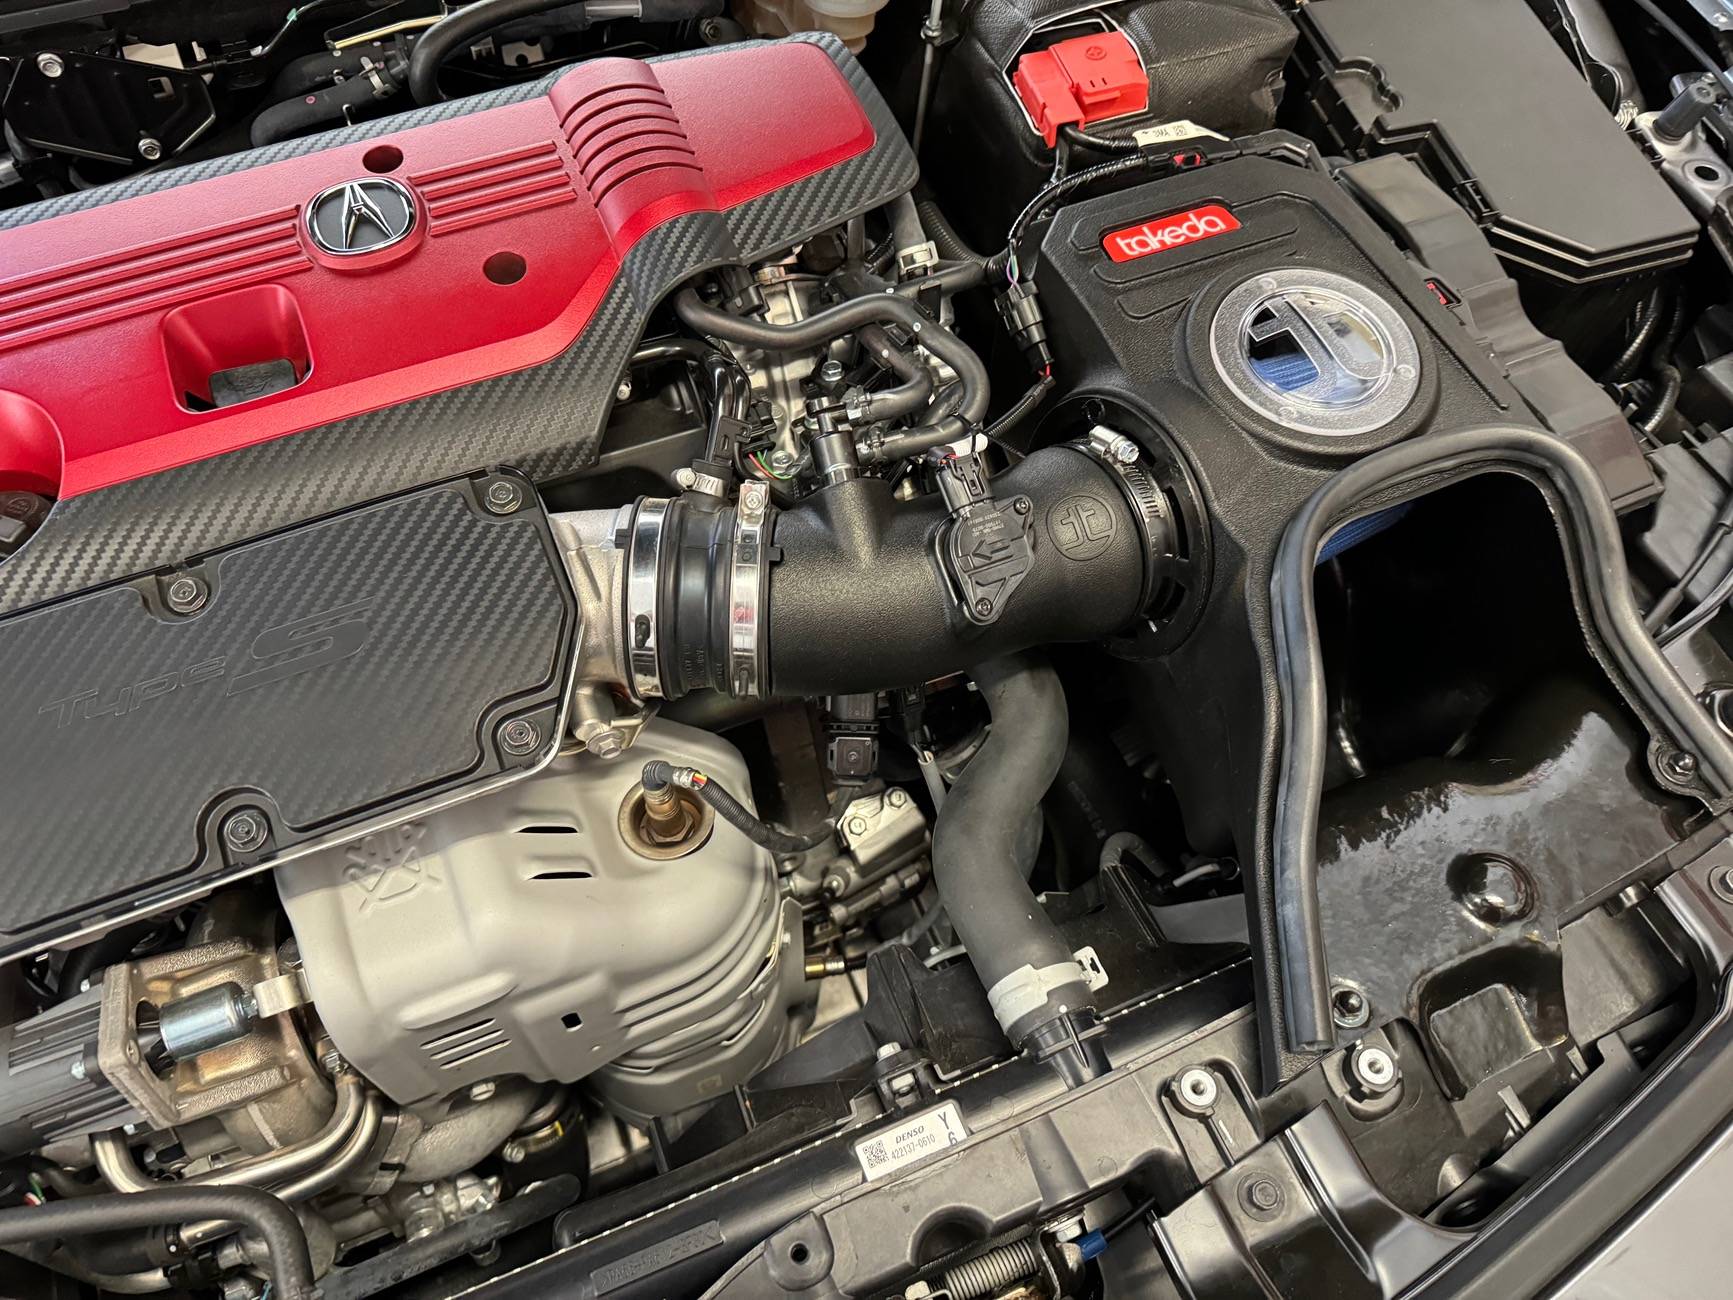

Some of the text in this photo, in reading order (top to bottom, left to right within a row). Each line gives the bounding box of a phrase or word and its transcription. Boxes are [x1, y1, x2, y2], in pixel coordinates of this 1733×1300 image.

[1116, 213, 1226, 256] takeda
[38, 596, 377, 728] TYPE S
[937, 1111, 950, 1130] Y
[895, 1125, 925, 1144] DENSO
[947, 1131, 958, 1147] 6
[891, 1133, 936, 1160] 422137-0610
